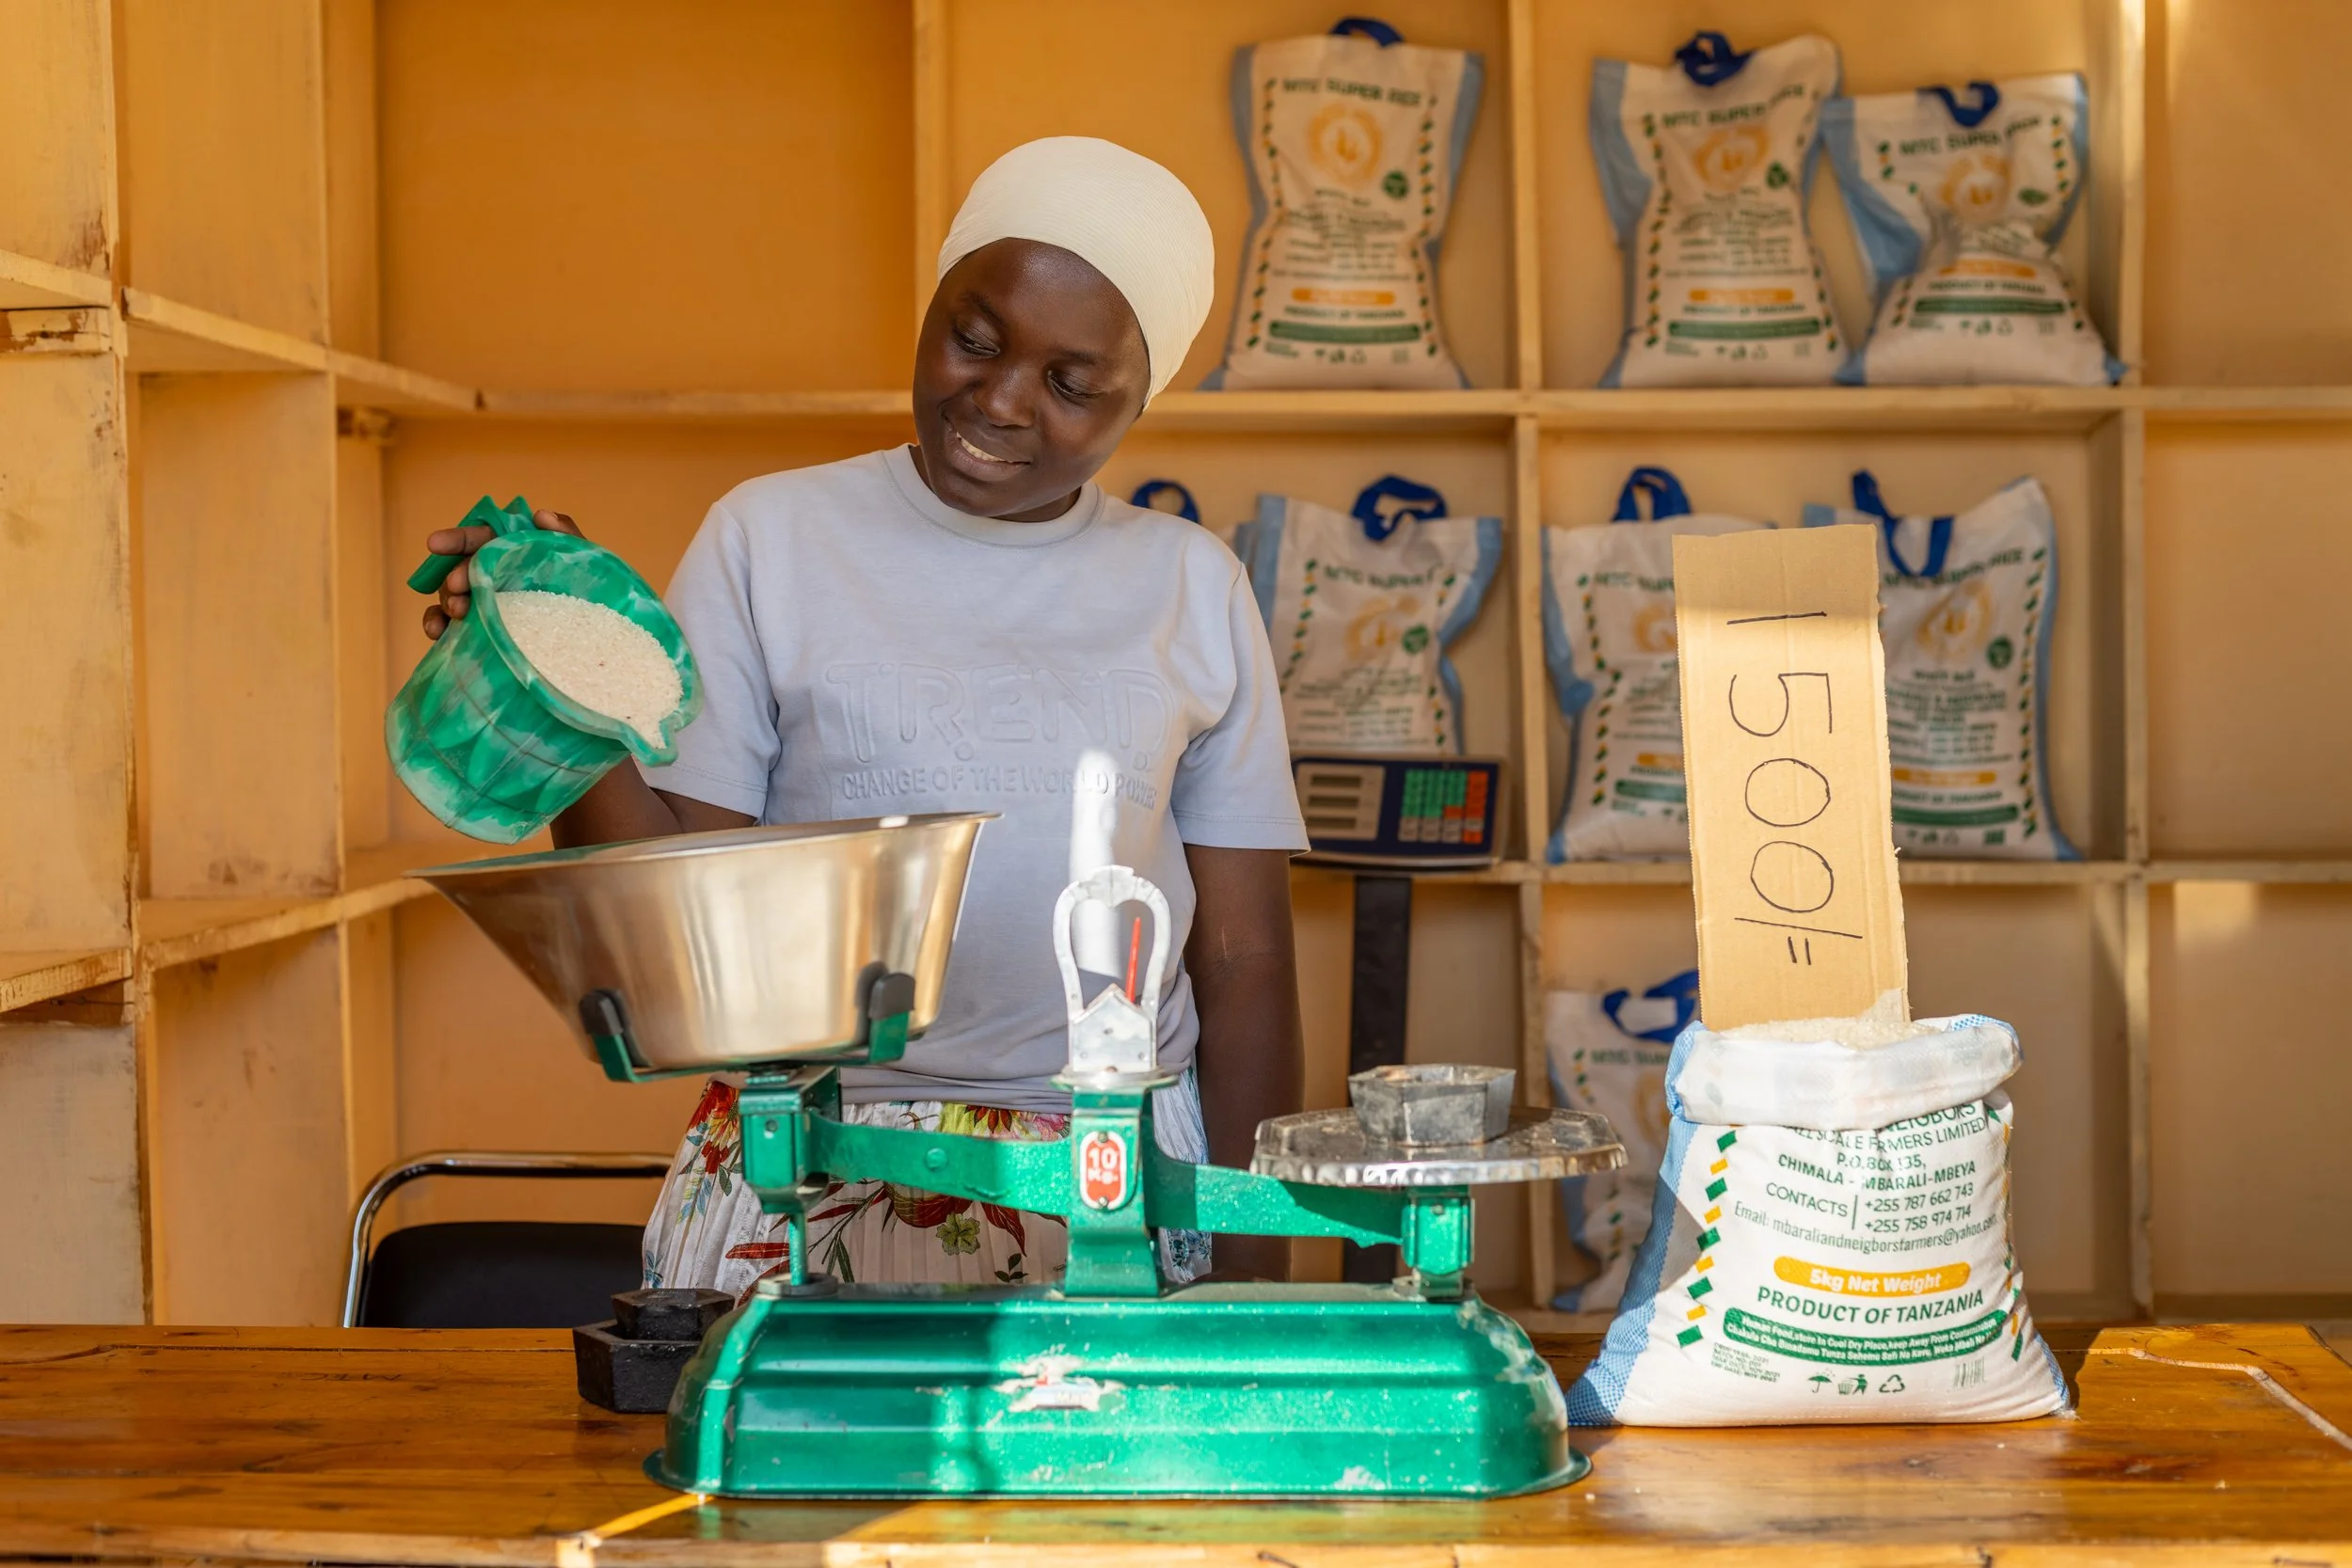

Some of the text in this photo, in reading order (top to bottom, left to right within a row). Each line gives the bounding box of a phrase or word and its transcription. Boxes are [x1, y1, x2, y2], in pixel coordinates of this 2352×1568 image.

[826, 662, 1175, 769] TREND
[842, 766, 928, 800] CHANGE
[930, 766, 964, 792] OF
[970, 767, 1019, 793] THE
[1868, 1131, 1932, 1153] FRMERS
[1935, 1117, 1986, 1144] LIMITED
[1089, 1148, 1118, 1170] 10
[1778, 1153, 1844, 1185] CHIMALA
[1765, 1181, 1848, 1217] CONTACTS
[1865, 1181, 1974, 1212] +255 787 662 743
[1734, 1200, 1770, 1227] Email:
[1865, 1203, 1972, 1233] +255 758 974 714
[1809, 1268, 1943, 1295] 5kg Net Weight
[1756, 1285, 1984, 1324] PRODUCT OF TANZANIA
[1741, 1316, 1772, 1332] Human
[1848, 1338, 1863, 1352] Dry
[1909, 1337, 1929, 1349] Away
[1931, 1333, 1949, 1343] From
[1760, 1335, 1778, 1347] Cha
